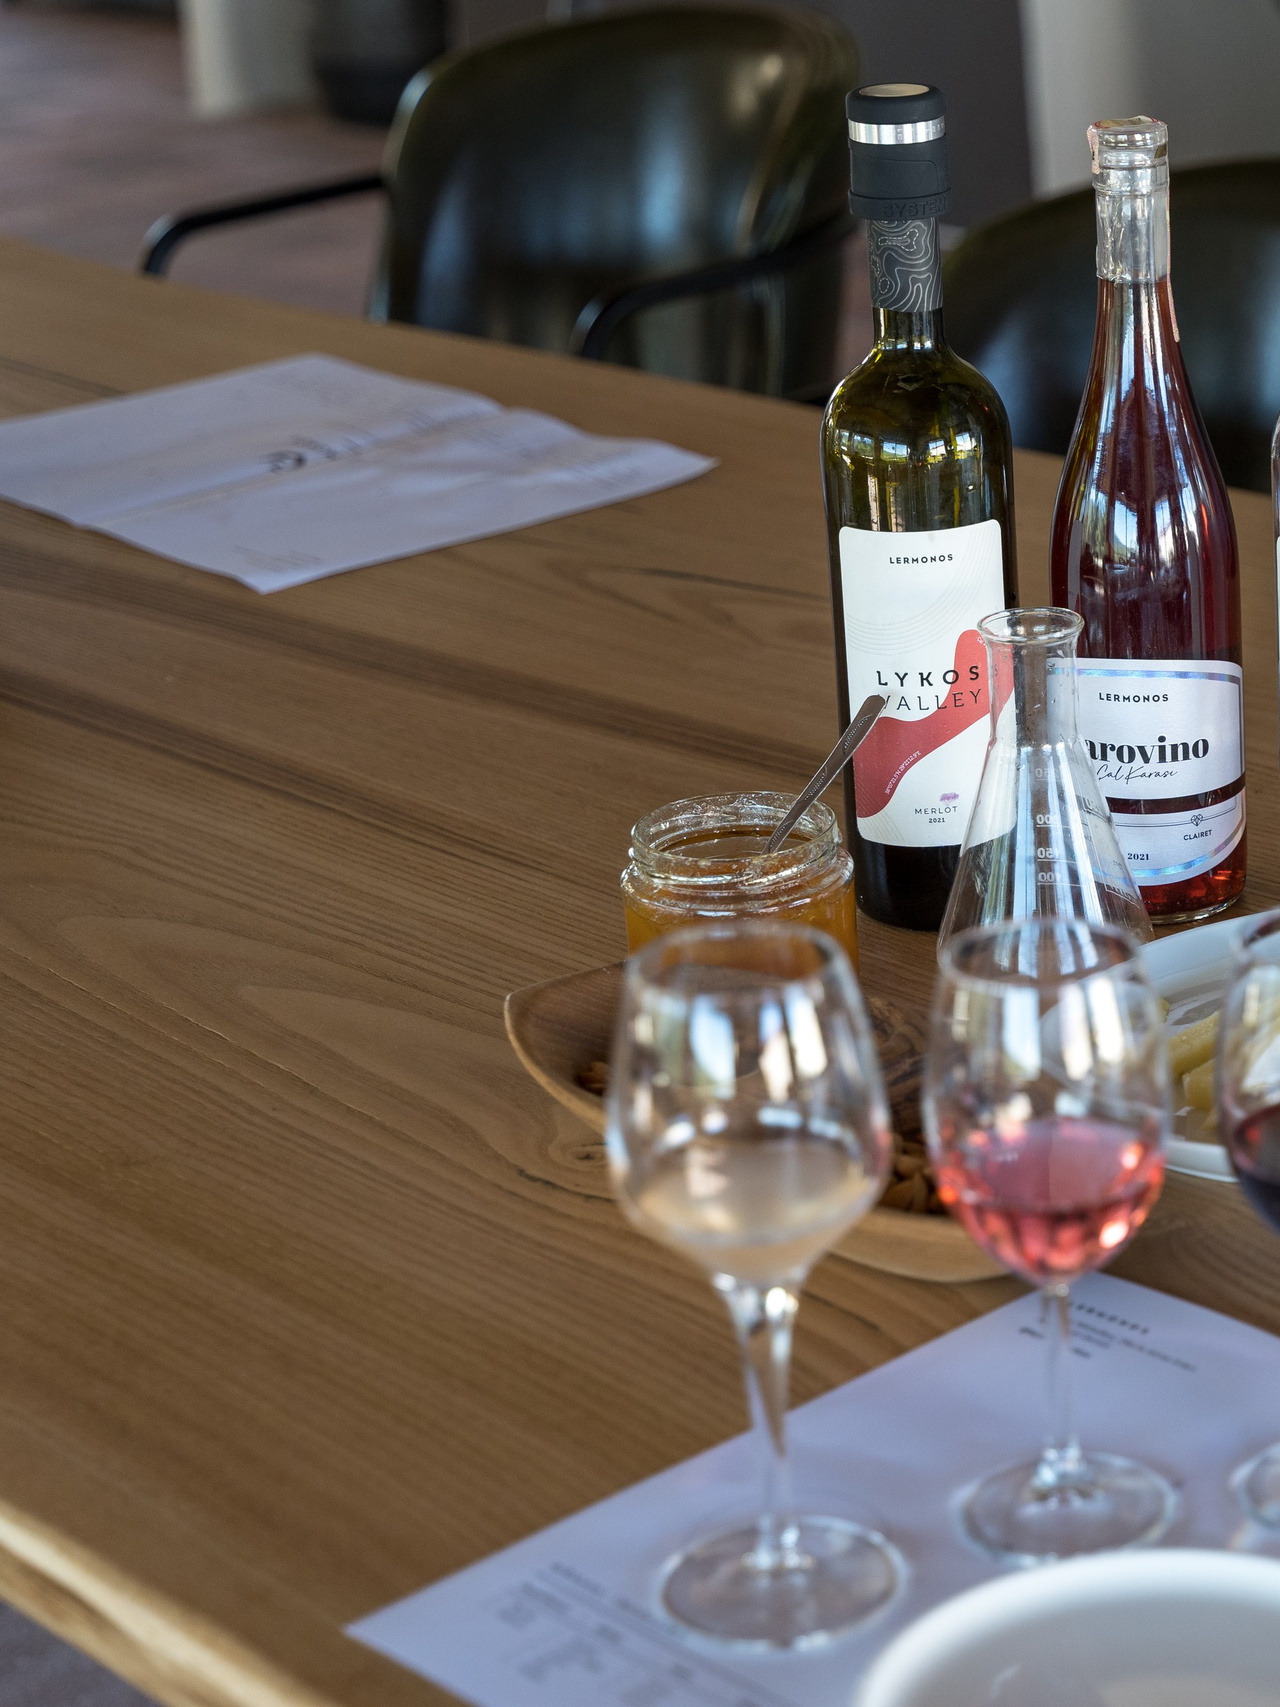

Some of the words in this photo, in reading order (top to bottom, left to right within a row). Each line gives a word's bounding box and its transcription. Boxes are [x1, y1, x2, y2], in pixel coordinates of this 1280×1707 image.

[882, 197, 947, 218] SYSTEM
[889, 553, 953, 564] LERMONOS
[876, 665, 980, 687] LYKOS
[1098, 692, 1169, 703] LERMONOS
[1084, 735, 1210, 764] arovino
[914, 806, 958, 815] MERLOT
[1183, 829, 1213, 841] CLAIRET
[1127, 852, 1150, 862] 2021
